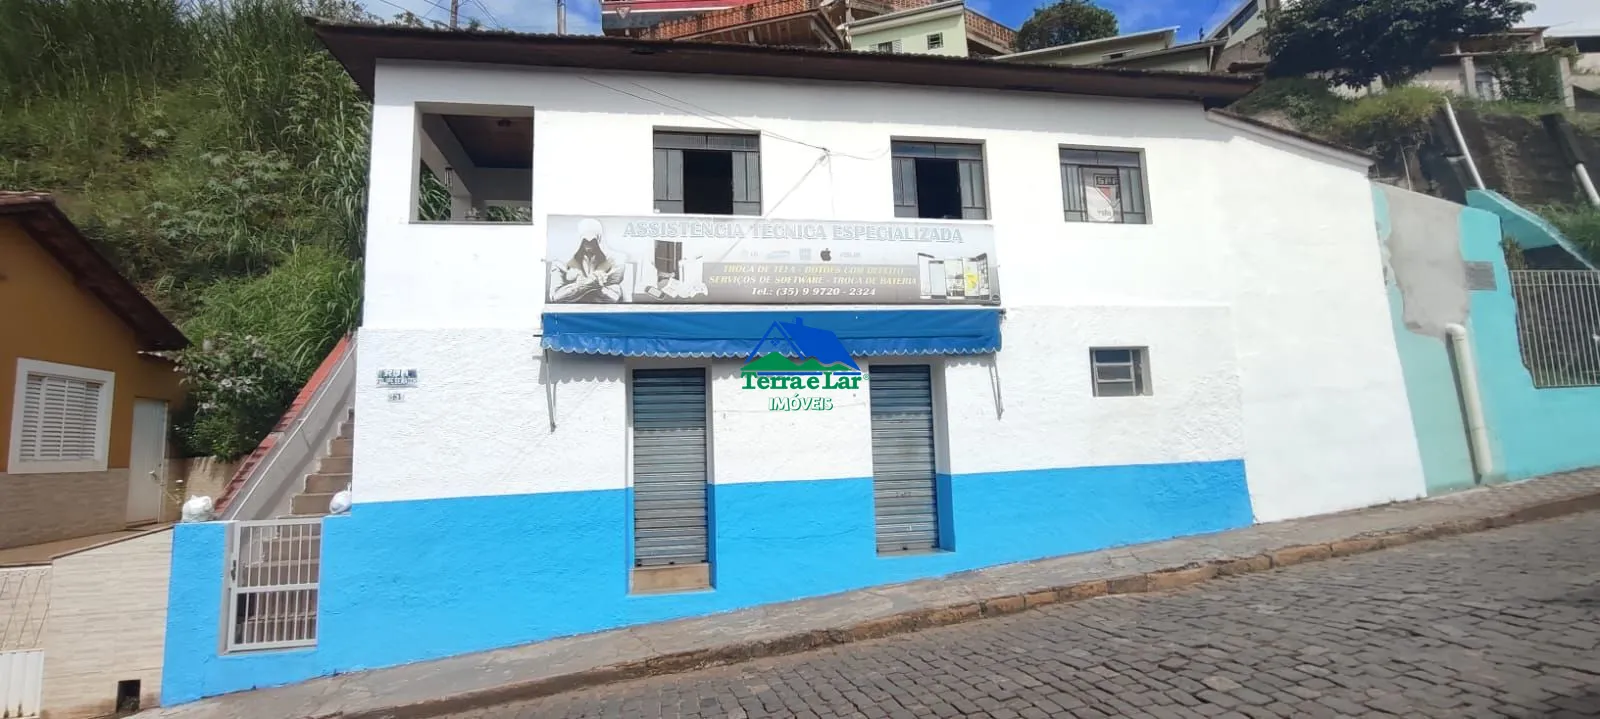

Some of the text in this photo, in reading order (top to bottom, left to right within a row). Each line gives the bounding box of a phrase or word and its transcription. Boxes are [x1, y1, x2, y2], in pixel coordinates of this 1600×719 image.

[832, 225, 964, 243] ESPECIALIZADA
[759, 275, 773, 284] DE
[775, 275, 824, 285] SOFTWARE
[833, 276, 862, 285] TROCA
[865, 276, 878, 285] DE
[880, 277, 917, 285] BATERIA
[776, 287, 799, 297] (35)
[802, 288, 810, 296] 9
[813, 288, 840, 296] 9720
[849, 288, 876, 296] 2324
